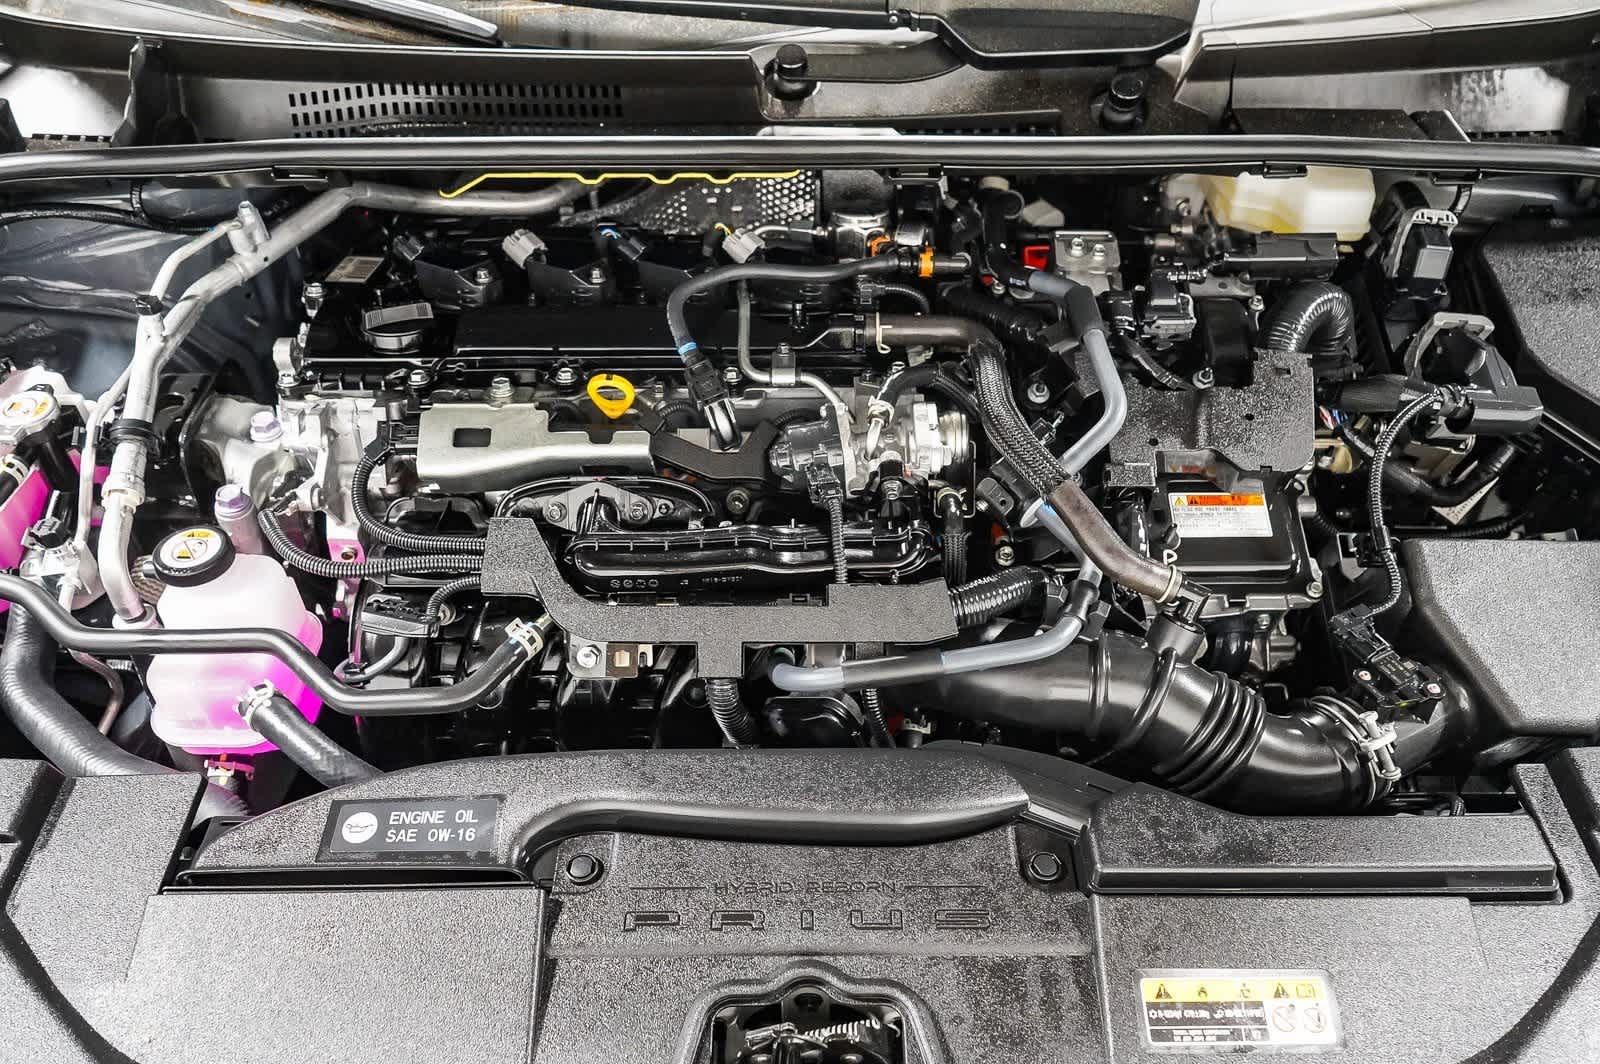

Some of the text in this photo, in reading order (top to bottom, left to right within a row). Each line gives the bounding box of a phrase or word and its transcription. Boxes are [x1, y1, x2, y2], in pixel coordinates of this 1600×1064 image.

[389, 810, 478, 825] ENGINE OIL
[386, 829, 475, 842] SAE 0W-16
[714, 880, 897, 894] HYBRID REBORN
[624, 910, 991, 931] PRIUS
